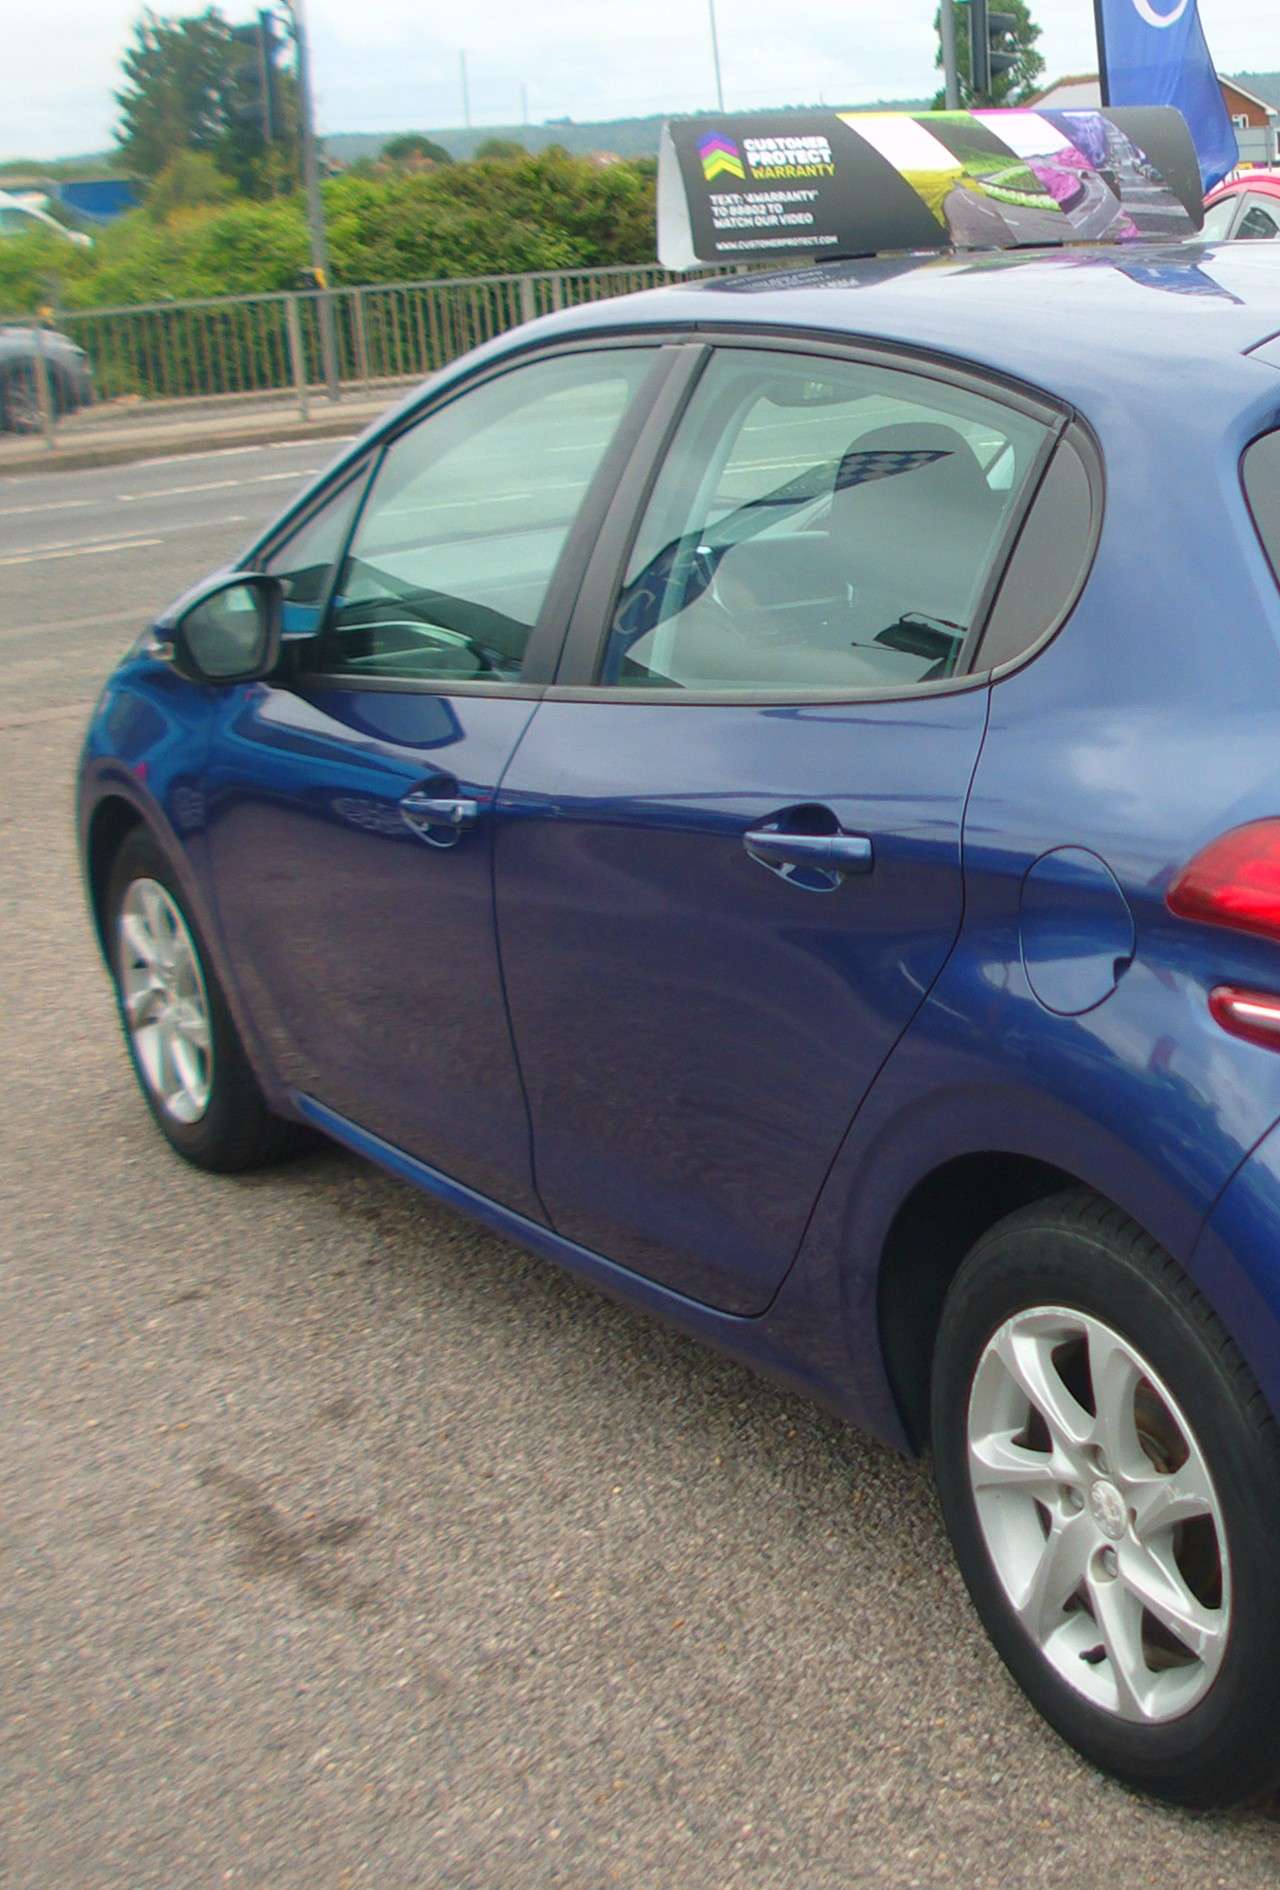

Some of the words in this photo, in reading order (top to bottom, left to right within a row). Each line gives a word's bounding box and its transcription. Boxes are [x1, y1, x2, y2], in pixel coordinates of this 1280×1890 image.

[743, 136, 829, 151] CUSTOMER
[746, 149, 832, 167] PROTECT
[751, 163, 835, 179] WARRANTY
[711, 206, 728, 217] TO
[767, 203, 784, 214] TO
[712, 216, 754, 229] WATCH
[754, 215, 779, 228] OUR
[778, 212, 814, 225] VIDEO
